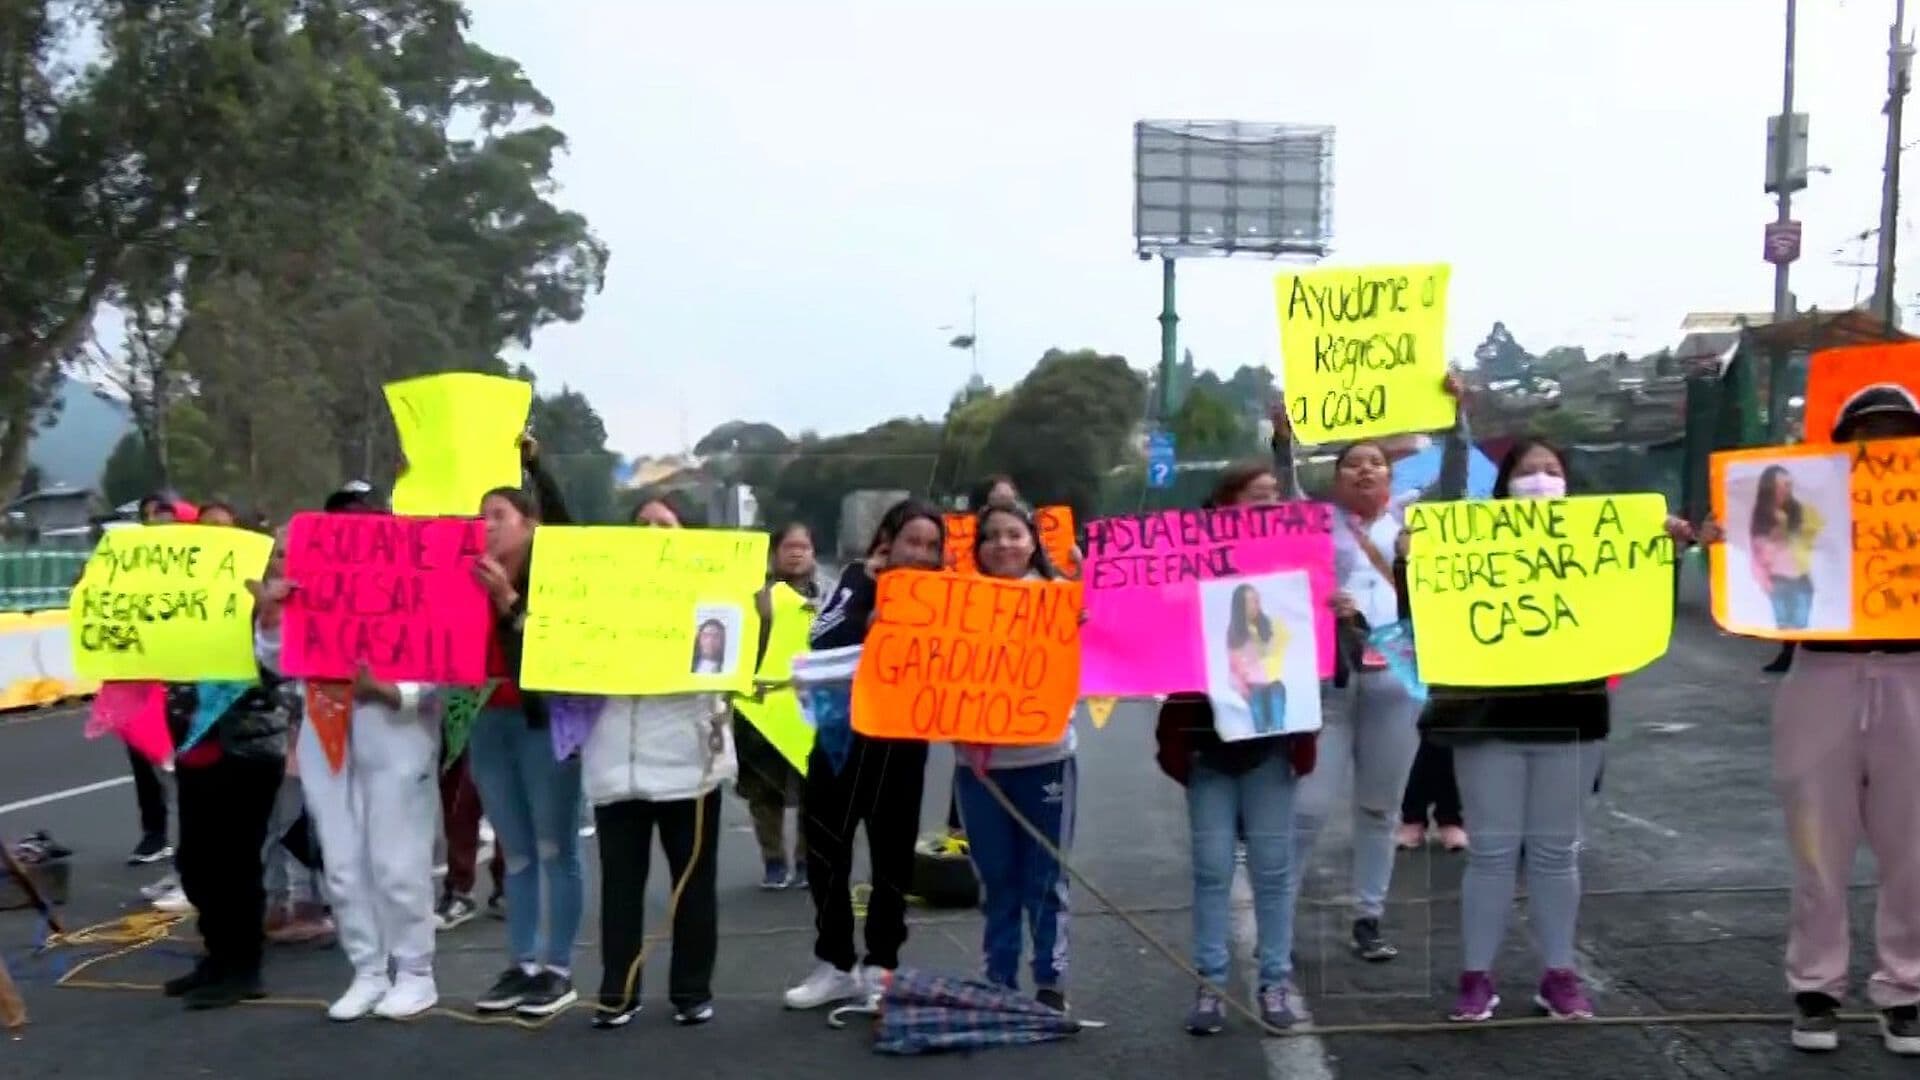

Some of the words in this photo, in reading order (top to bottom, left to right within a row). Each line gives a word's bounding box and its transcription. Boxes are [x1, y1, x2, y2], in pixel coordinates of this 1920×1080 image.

[1288, 275, 1408, 327] Ayudame
[1322, 385, 1386, 430] casa
[1406, 499, 1568, 545] AYUDAME
[1592, 499, 1624, 538] A
[214, 550, 236, 580] A
[1093, 545, 1240, 591] ESTEFANI
[1593, 539, 1621, 575] A
[1468, 593, 1579, 646] CASA
[910, 685, 1049, 737] OLMOS
